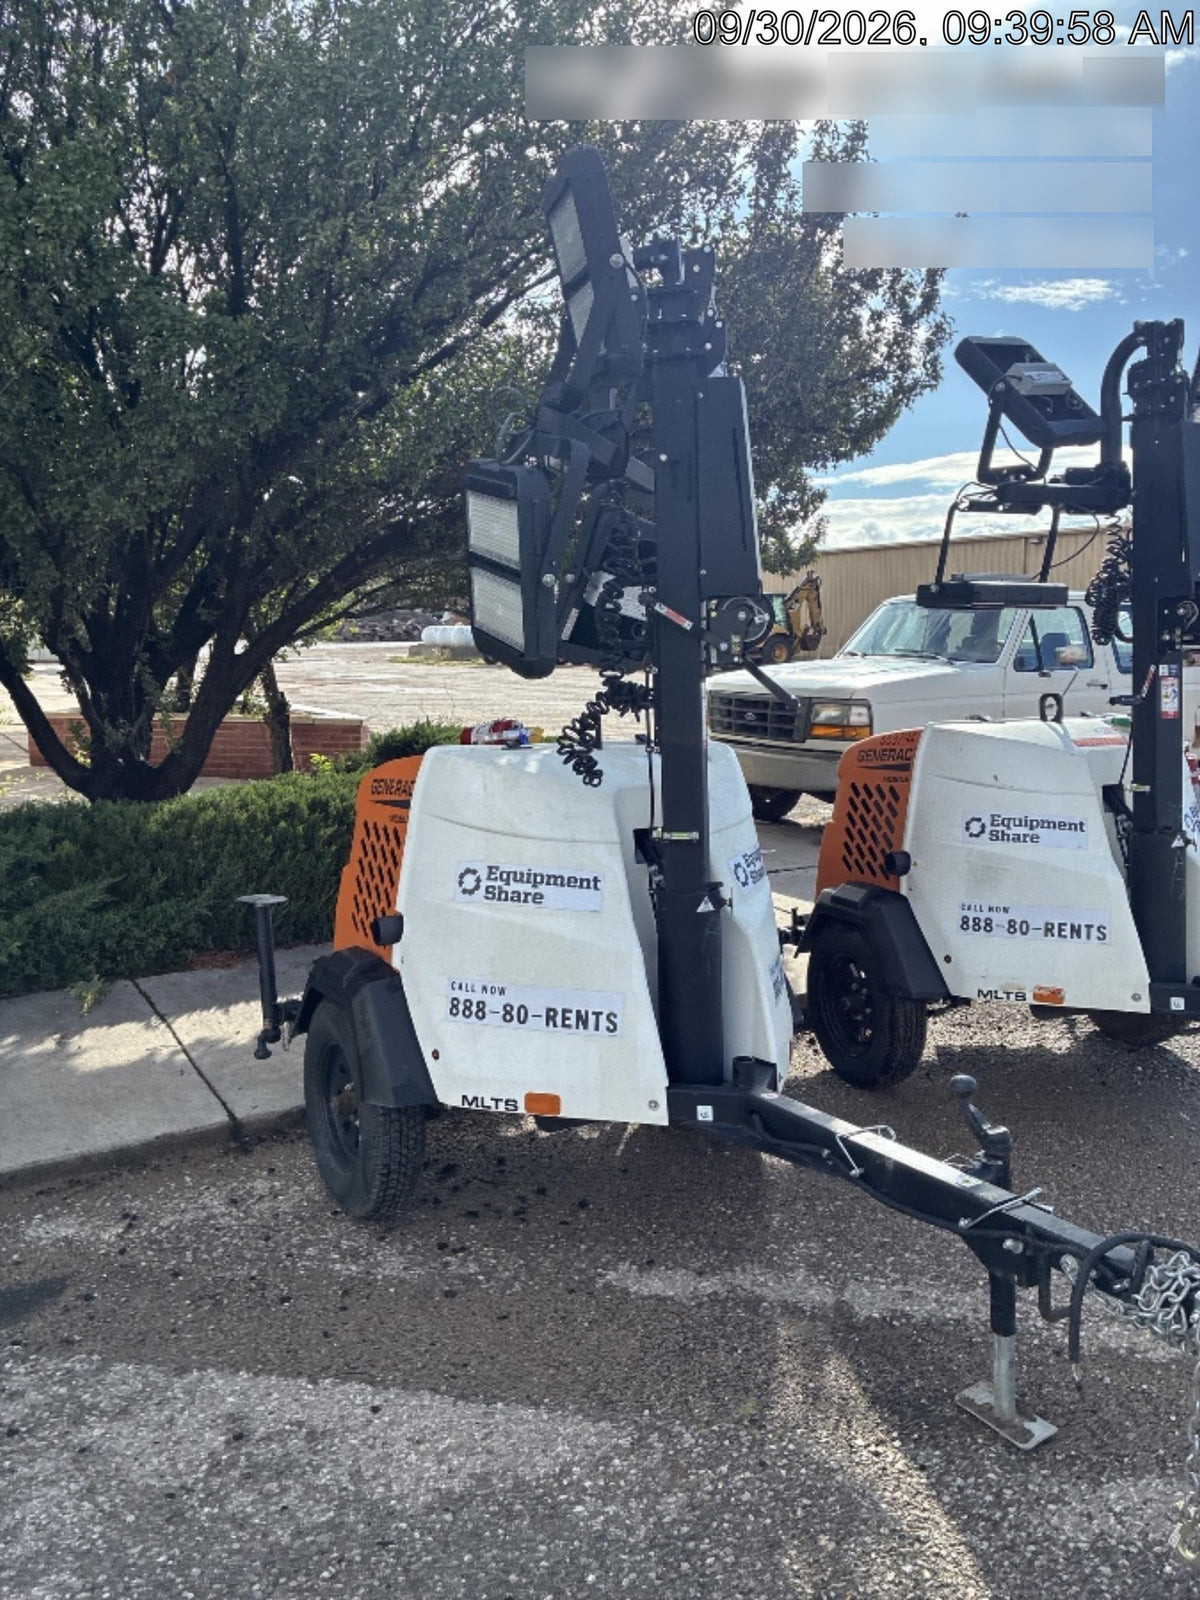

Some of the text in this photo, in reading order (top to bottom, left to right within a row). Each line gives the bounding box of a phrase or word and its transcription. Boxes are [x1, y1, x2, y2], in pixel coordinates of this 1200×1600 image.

[989, 813, 1086, 833] Equipment
[988, 829, 1041, 844] Share
[486, 865, 601, 891] Equipment
[484, 885, 545, 905] Share
[960, 903, 985, 914] CALL
[959, 914, 1108, 942] 888-80-RENTS
[450, 980, 507, 996] CALL NOW
[449, 996, 618, 1034] 888-80-RENTS
[461, 1094, 519, 1112] MLTS
